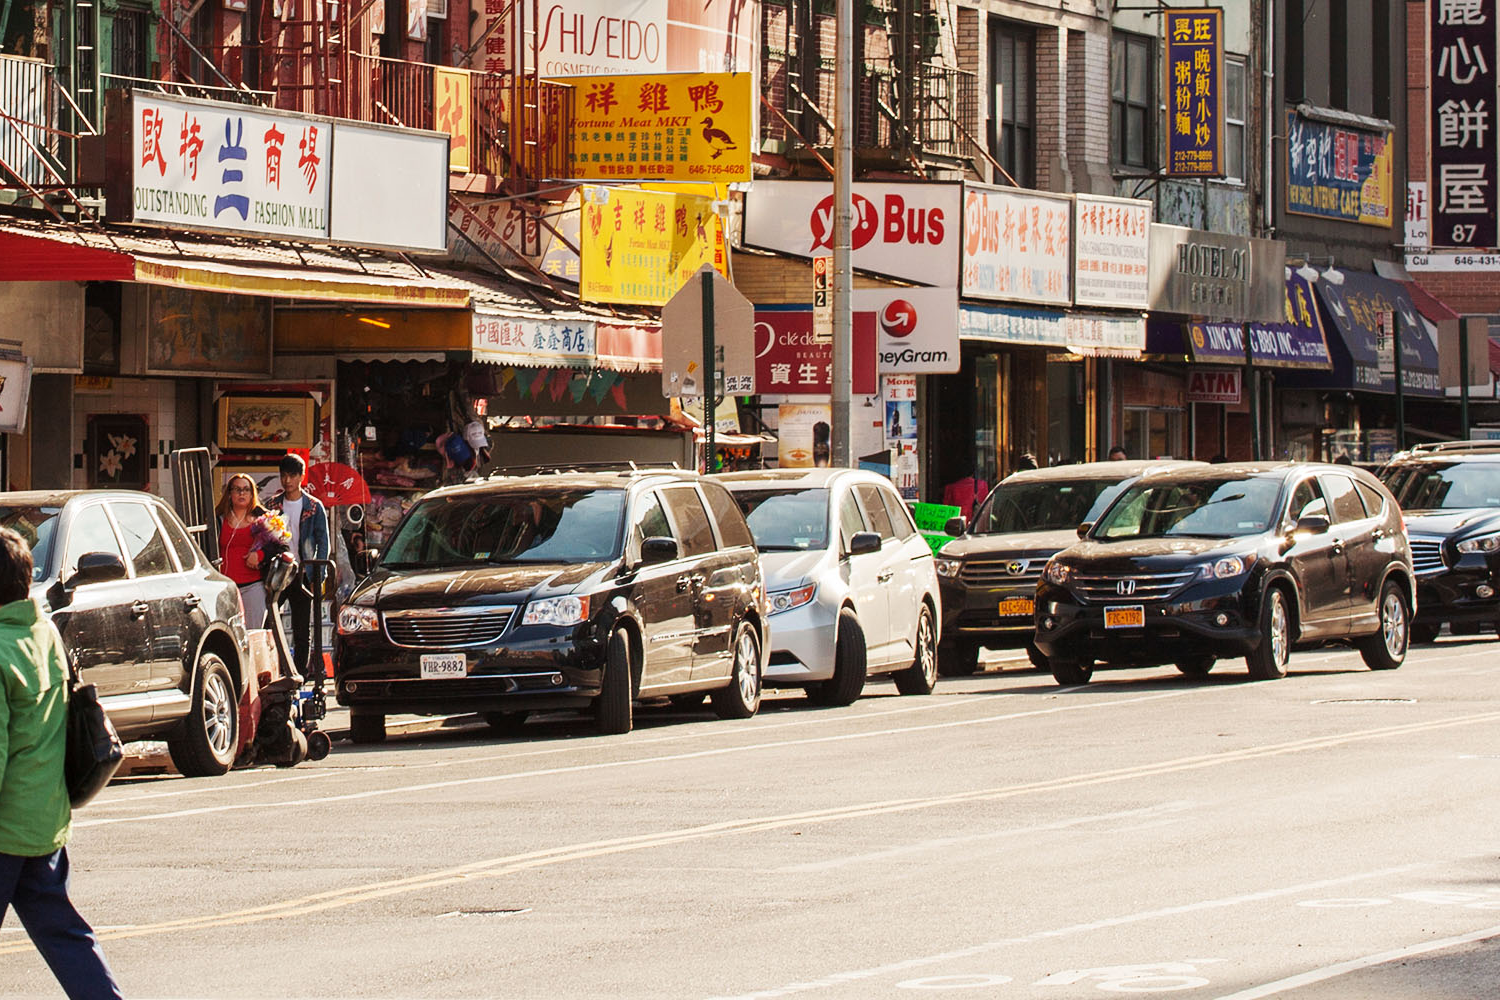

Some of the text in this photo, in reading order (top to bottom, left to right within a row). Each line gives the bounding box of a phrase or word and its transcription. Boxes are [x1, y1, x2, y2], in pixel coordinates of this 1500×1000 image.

[529, 4, 660, 63] SHISEIDO
[1173, 18, 1212, 41] 興旺
[620, 117, 651, 128] Meat
[656, 116, 691, 127] MKT
[689, 164, 744, 175] 646-756-4628
[134, 187, 326, 230] OUTSTANDING FASHION MALL
[883, 194, 945, 245] Bus
[1452, 224, 1477, 243] 87
[1177, 243, 1228, 278] HOTEL
[817, 292, 824, 306] 2
[879, 349, 948, 366] neyGram
[1190, 373, 1236, 394] ATM
[423, 660, 464, 673] VHR-9882
